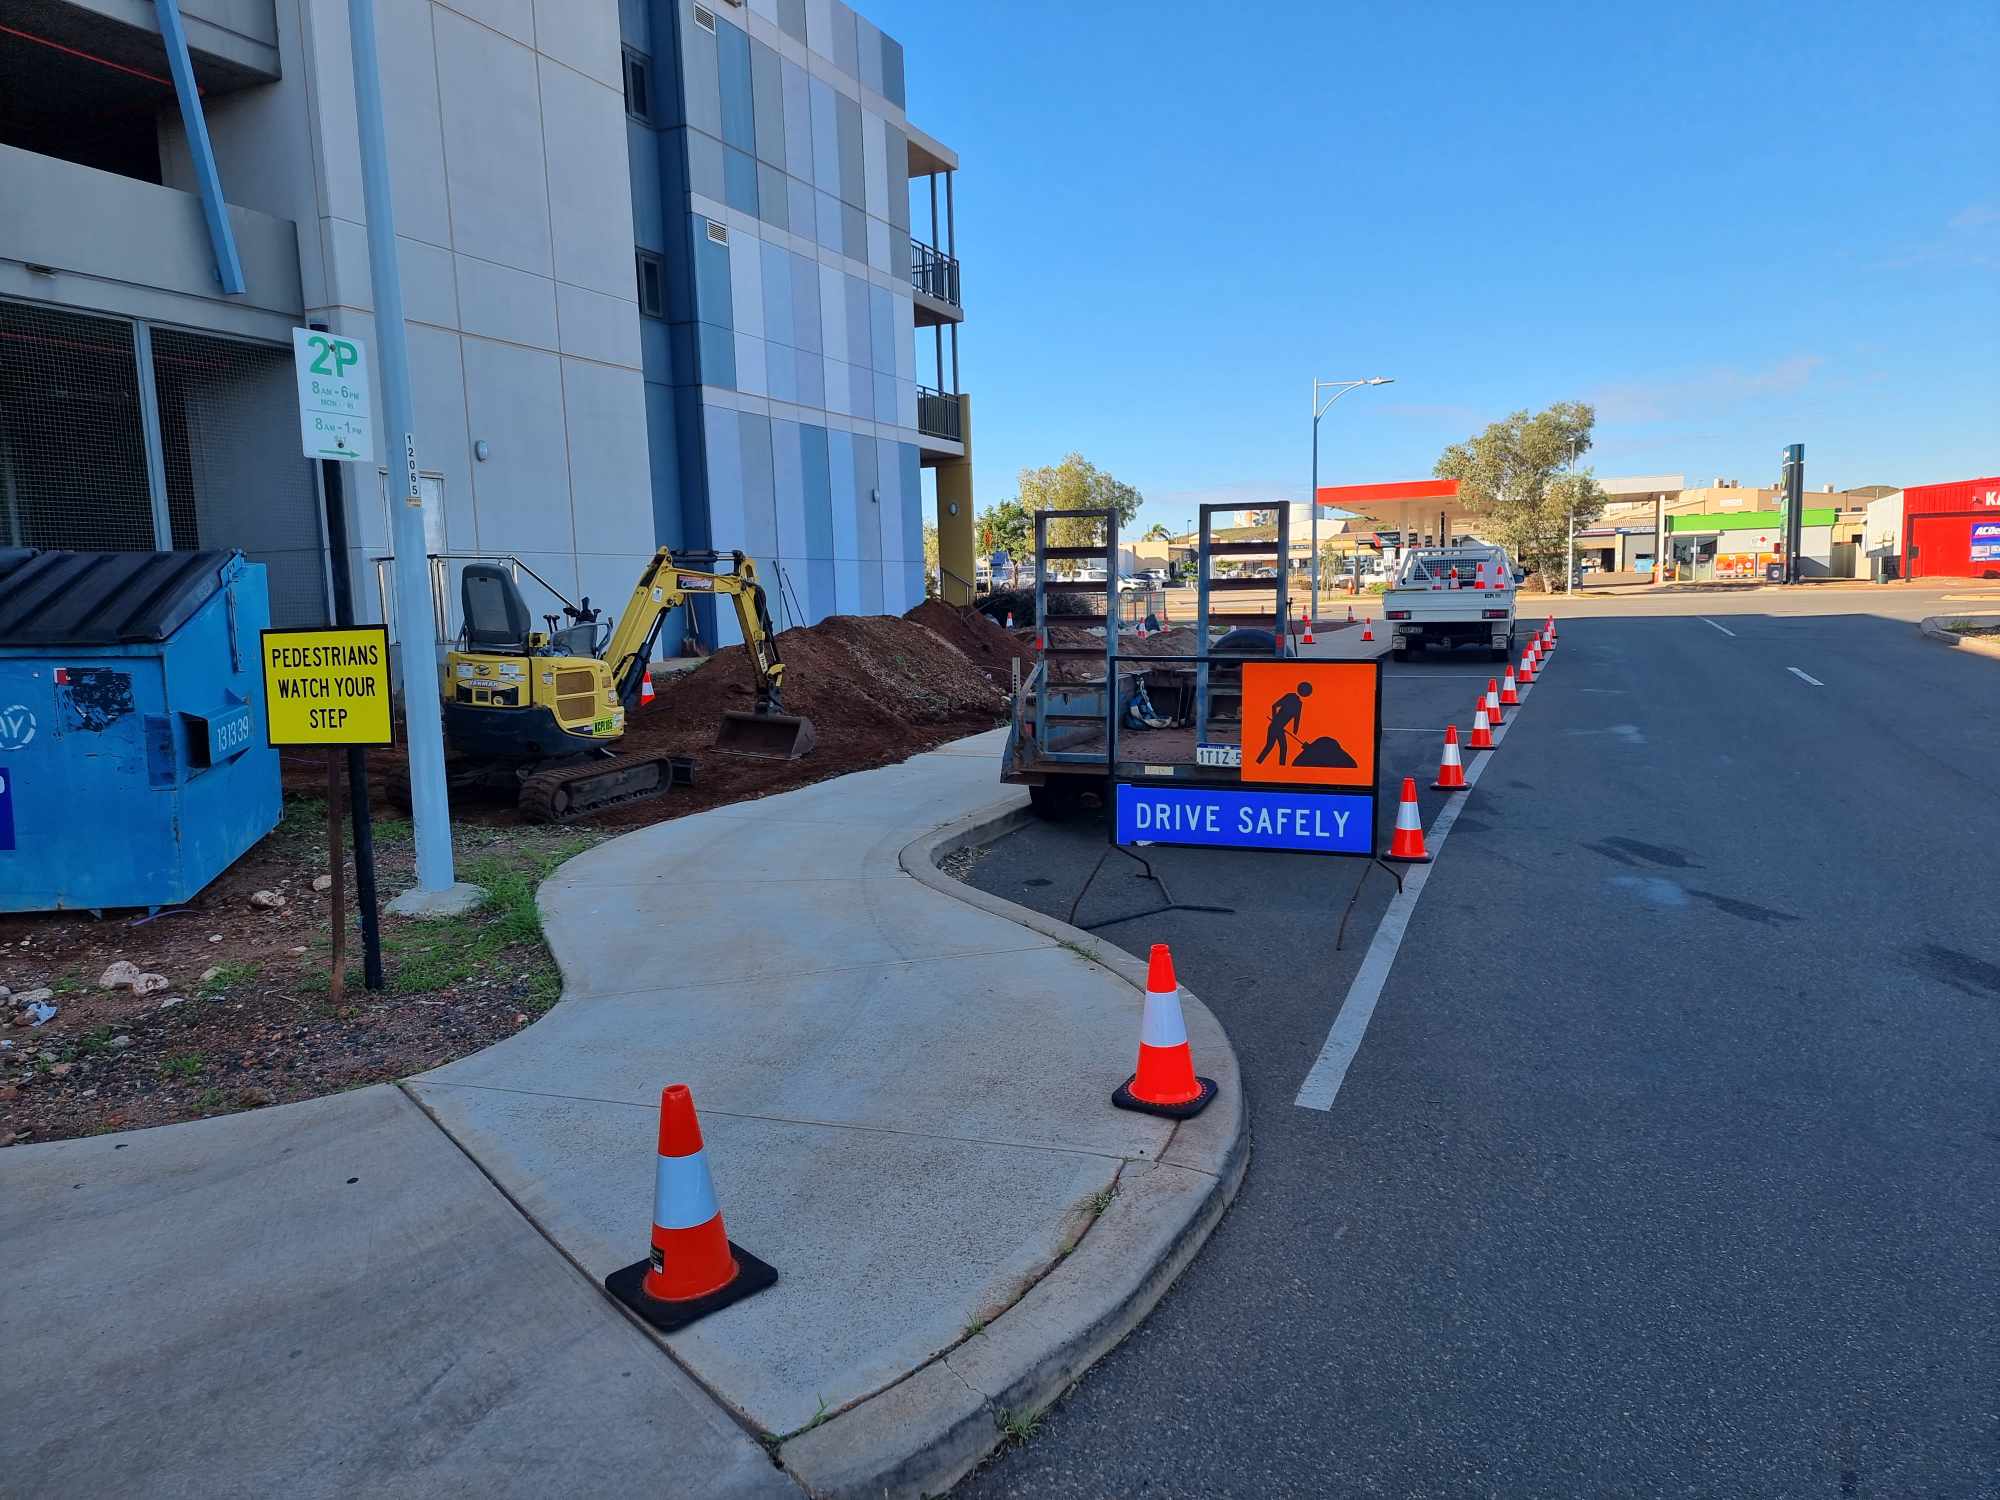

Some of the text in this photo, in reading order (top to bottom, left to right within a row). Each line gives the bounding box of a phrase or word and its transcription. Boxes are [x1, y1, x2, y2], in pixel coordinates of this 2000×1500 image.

[307, 335, 358, 378] 2P
[406, 434, 418, 495] 12065
[272, 645, 378, 668] PEDESTRIANS
[278, 677, 376, 698] WATCH YOUR
[310, 708, 348, 729] STEP
[1136, 802, 1350, 838] DRIVE SAFELY
